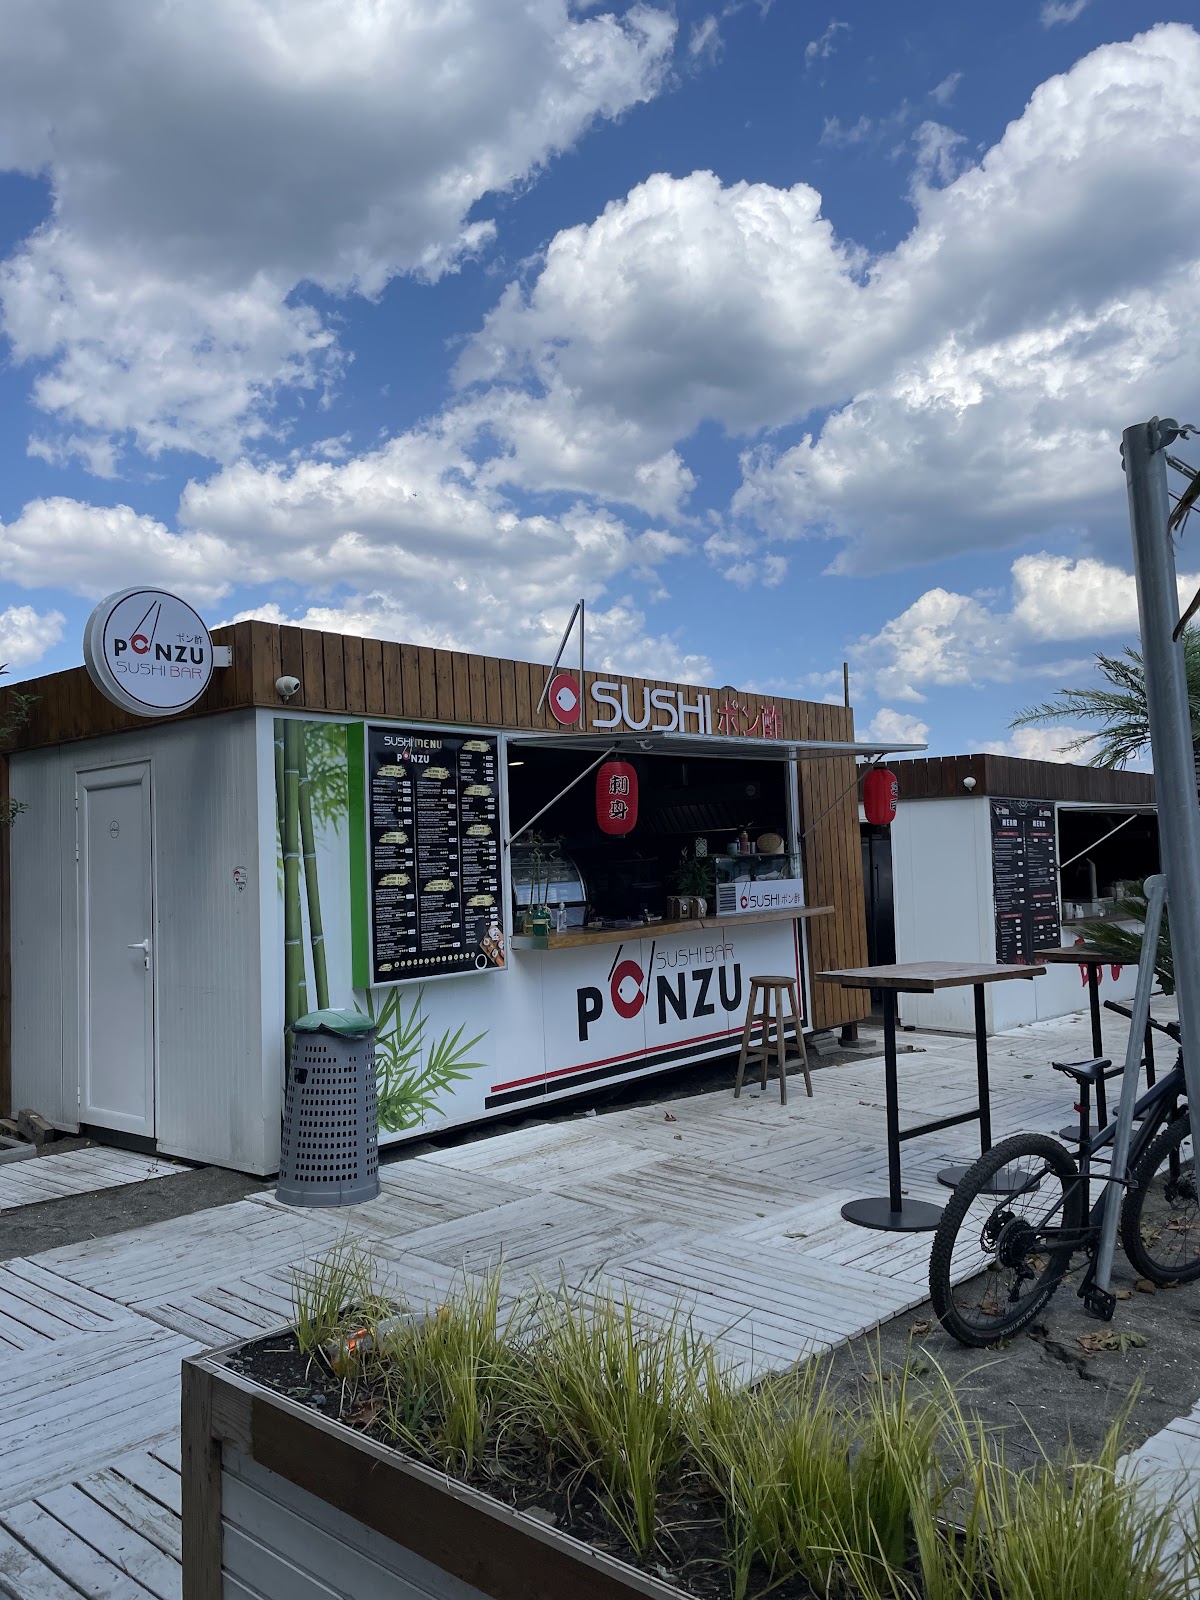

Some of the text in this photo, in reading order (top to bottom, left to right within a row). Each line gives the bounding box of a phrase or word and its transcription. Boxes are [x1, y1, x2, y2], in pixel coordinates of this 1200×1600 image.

[116, 661, 202, 679] SUSHI BAR
[590, 680, 712, 735] SUSHI
[717, 700, 783, 739] ポン酢
[384, 736, 443, 749] SUSHI MENU
[749, 893, 780, 909] SUSHI
[656, 943, 735, 970] SUSHI BAR
